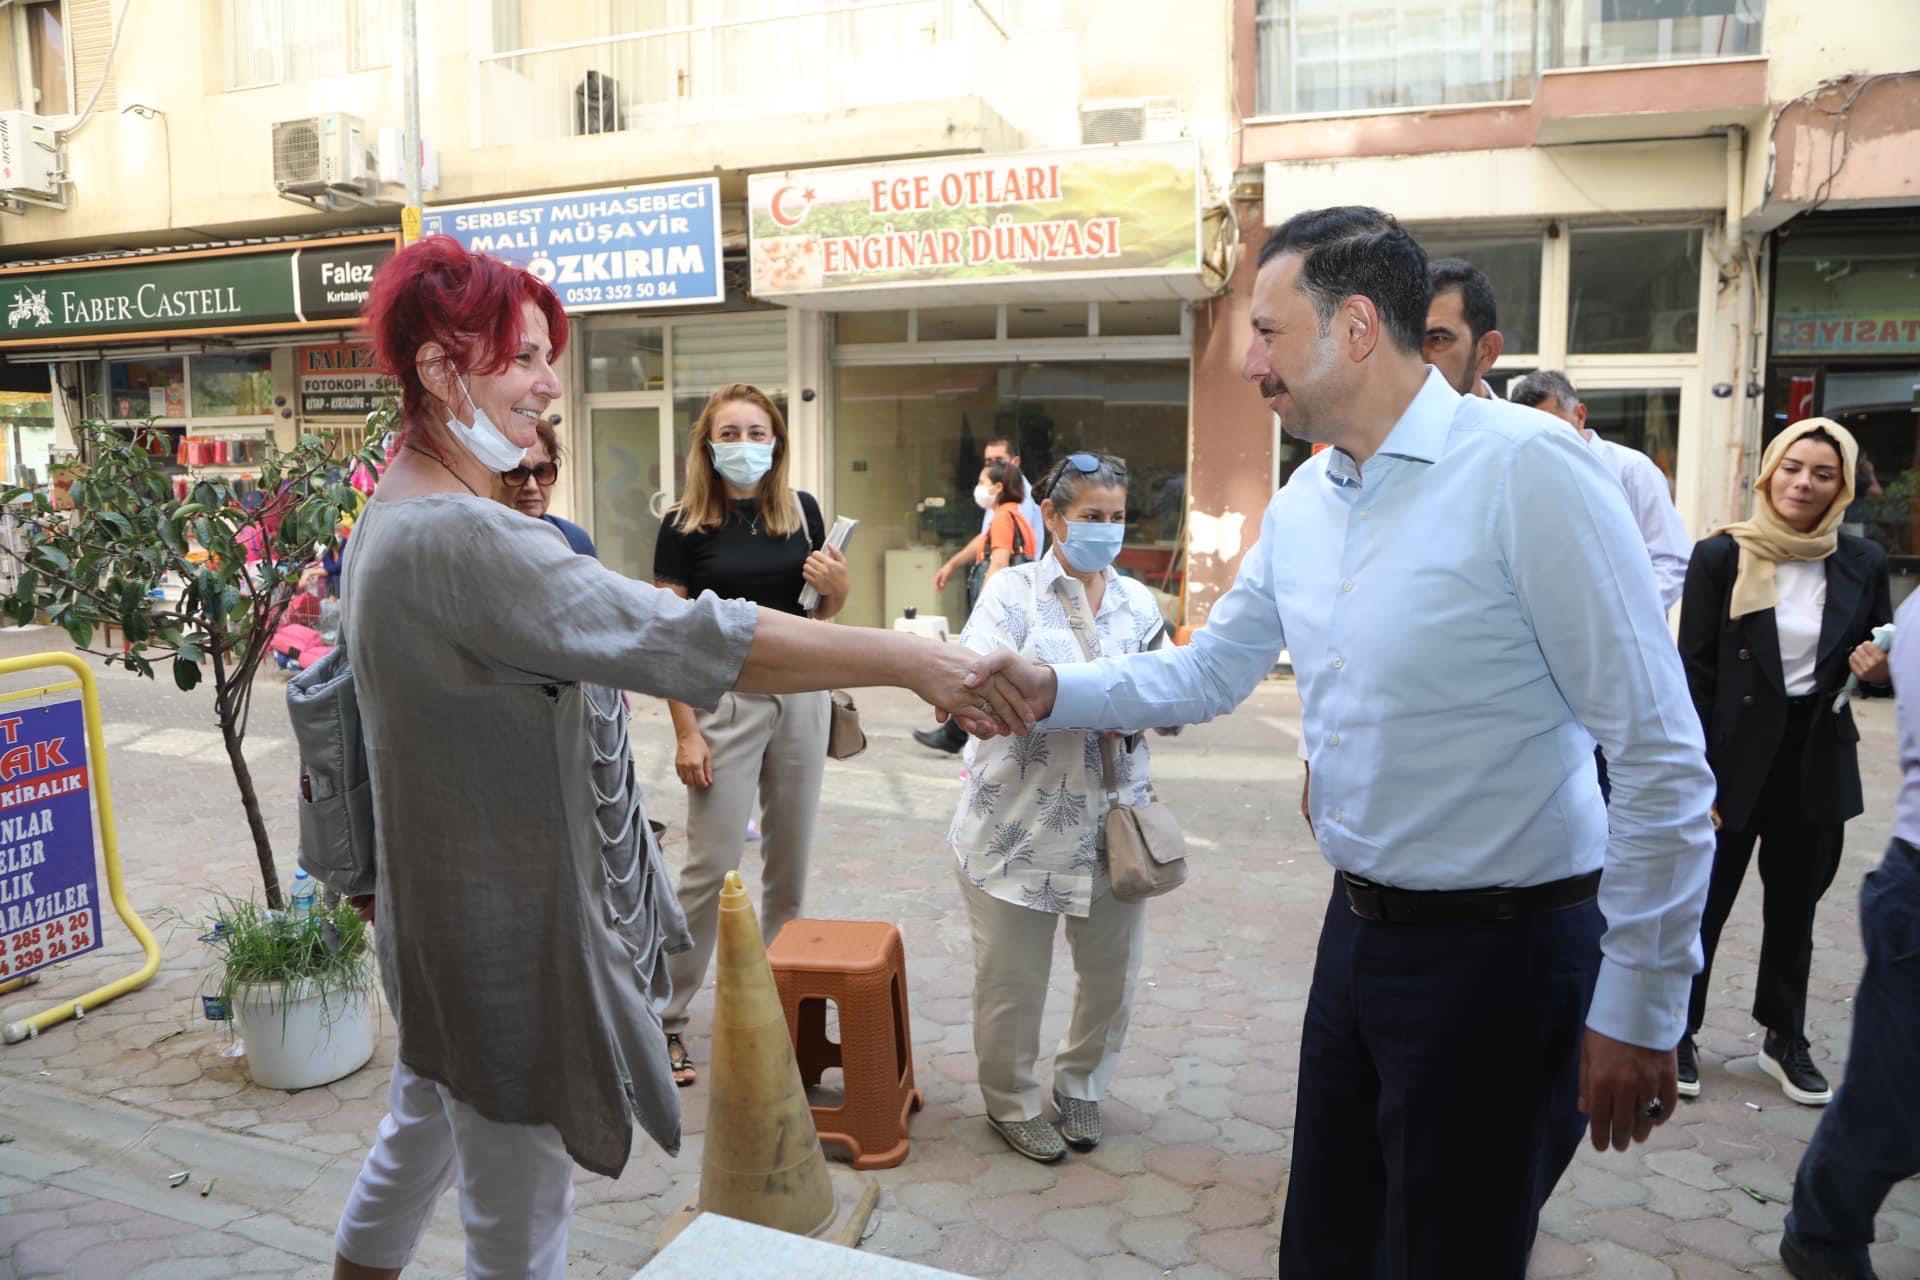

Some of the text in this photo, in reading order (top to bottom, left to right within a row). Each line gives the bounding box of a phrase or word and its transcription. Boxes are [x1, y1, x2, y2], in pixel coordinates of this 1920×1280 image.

[871, 164, 1062, 213] EGE OTLARI
[455, 207, 544, 231] SERBEST
[551, 187, 705, 222] MUHASEBECİ
[470, 227, 538, 251] MALİ
[548, 215, 690, 245] MÜŞAVİR
[822, 216, 1120, 273] ENGİNAR DÜNYASI
[321, 261, 374, 286] Falez
[526, 245, 705, 284] ÖZKIRIM
[567, 281, 677, 303] 0532 352 50 84
[304, 376, 366, 391] FOTOKOPİ
[1, 774, 83, 808] KİRALIK
[12, 928, 41, 952] 285
[46, 920, 64, 937] 24
[69, 911, 89, 931] 20
[15, 947, 44, 971] 339
[49, 939, 67, 959] 24
[72, 931, 90, 951] 34
